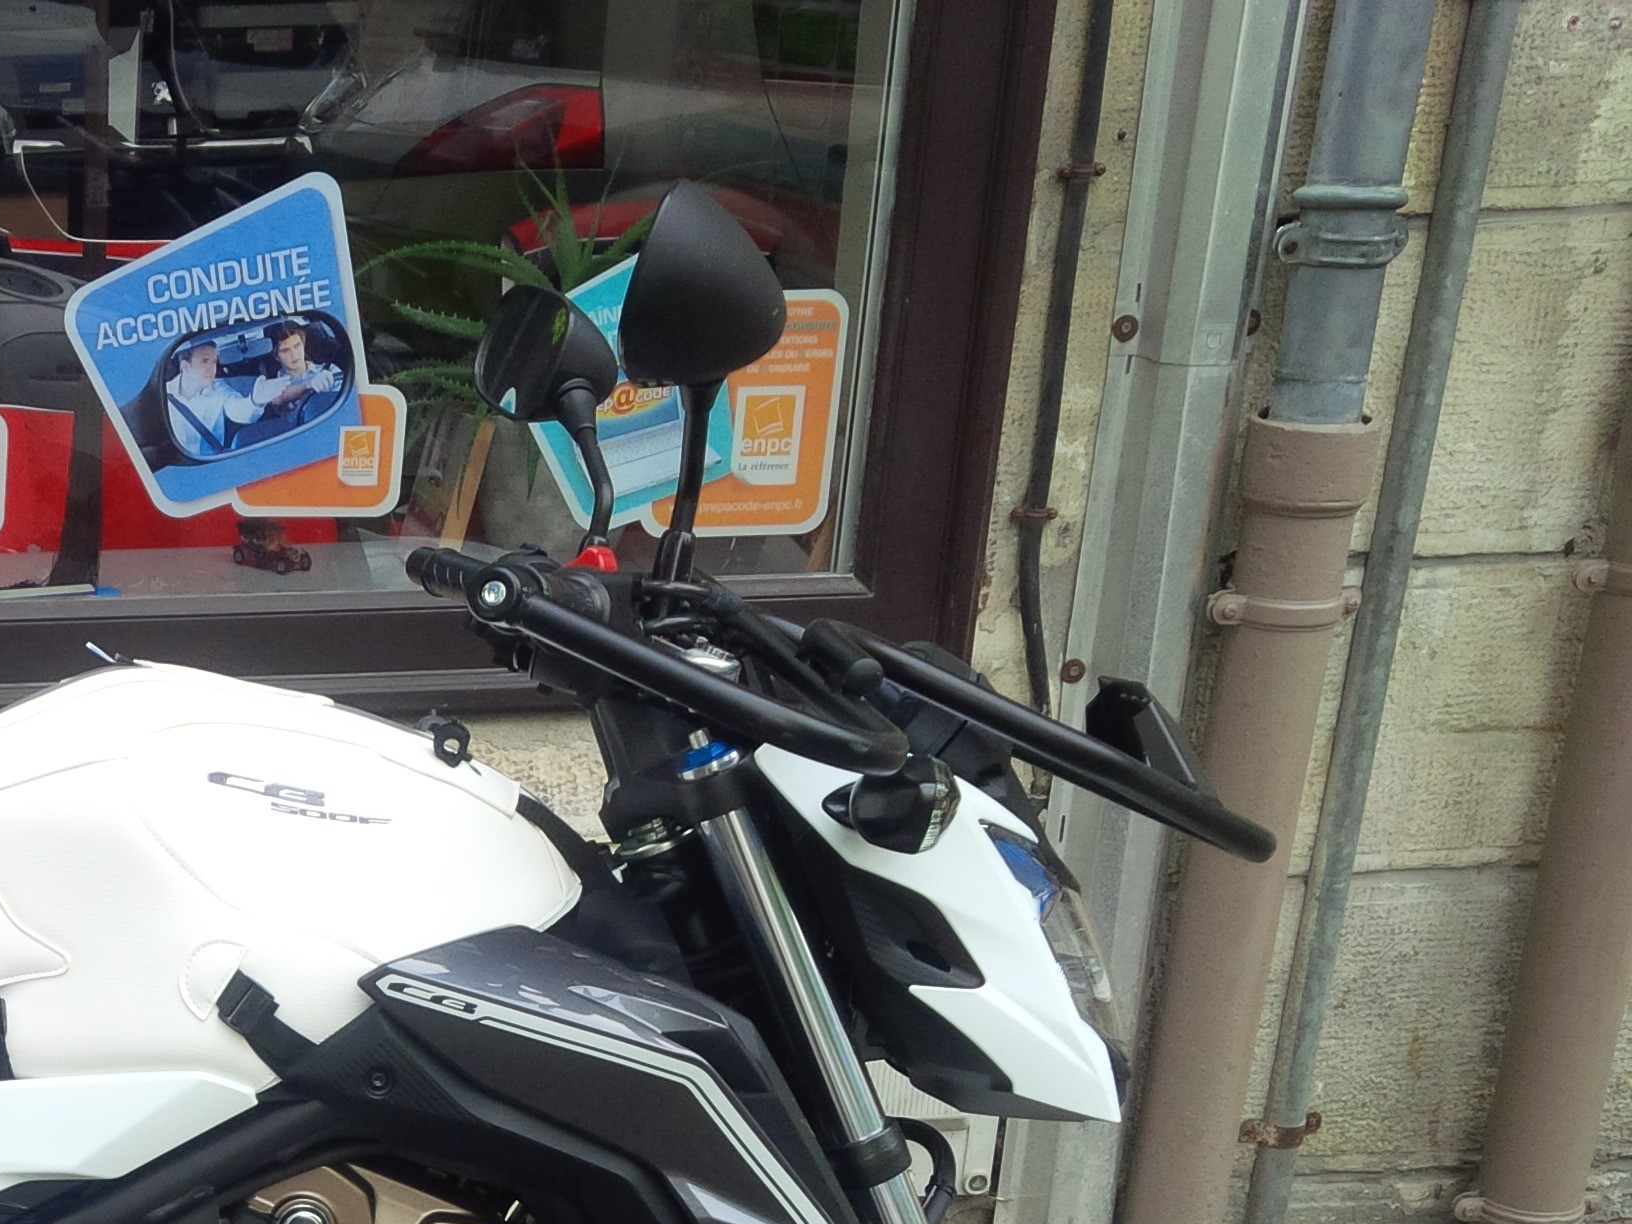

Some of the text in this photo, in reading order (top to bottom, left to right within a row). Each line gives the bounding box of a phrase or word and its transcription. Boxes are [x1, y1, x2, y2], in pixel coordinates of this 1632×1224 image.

[147, 246, 311, 304] CONDUITE
[96, 277, 332, 350] ACCOMPAGNÉE
[738, 462, 790, 471] La référence
[741, 437, 792, 457] enpc
